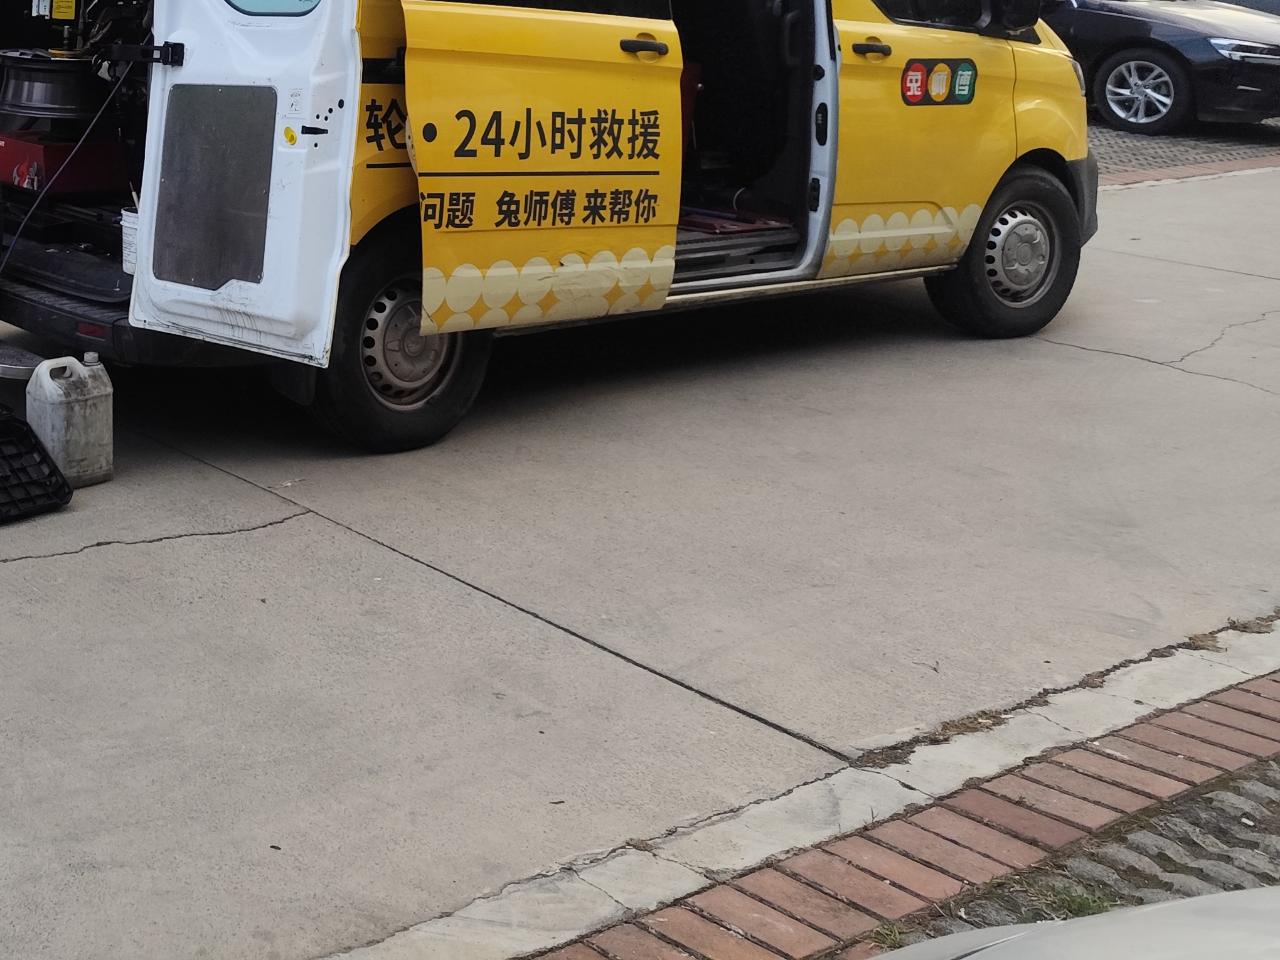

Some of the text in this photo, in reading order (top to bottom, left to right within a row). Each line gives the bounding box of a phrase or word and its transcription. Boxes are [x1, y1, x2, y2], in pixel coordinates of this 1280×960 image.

[366, 98, 408, 151] 轮
[453, 107, 661, 160] 24小时救援
[420, 188, 658, 229] 问题 兔师傅 来帮你
